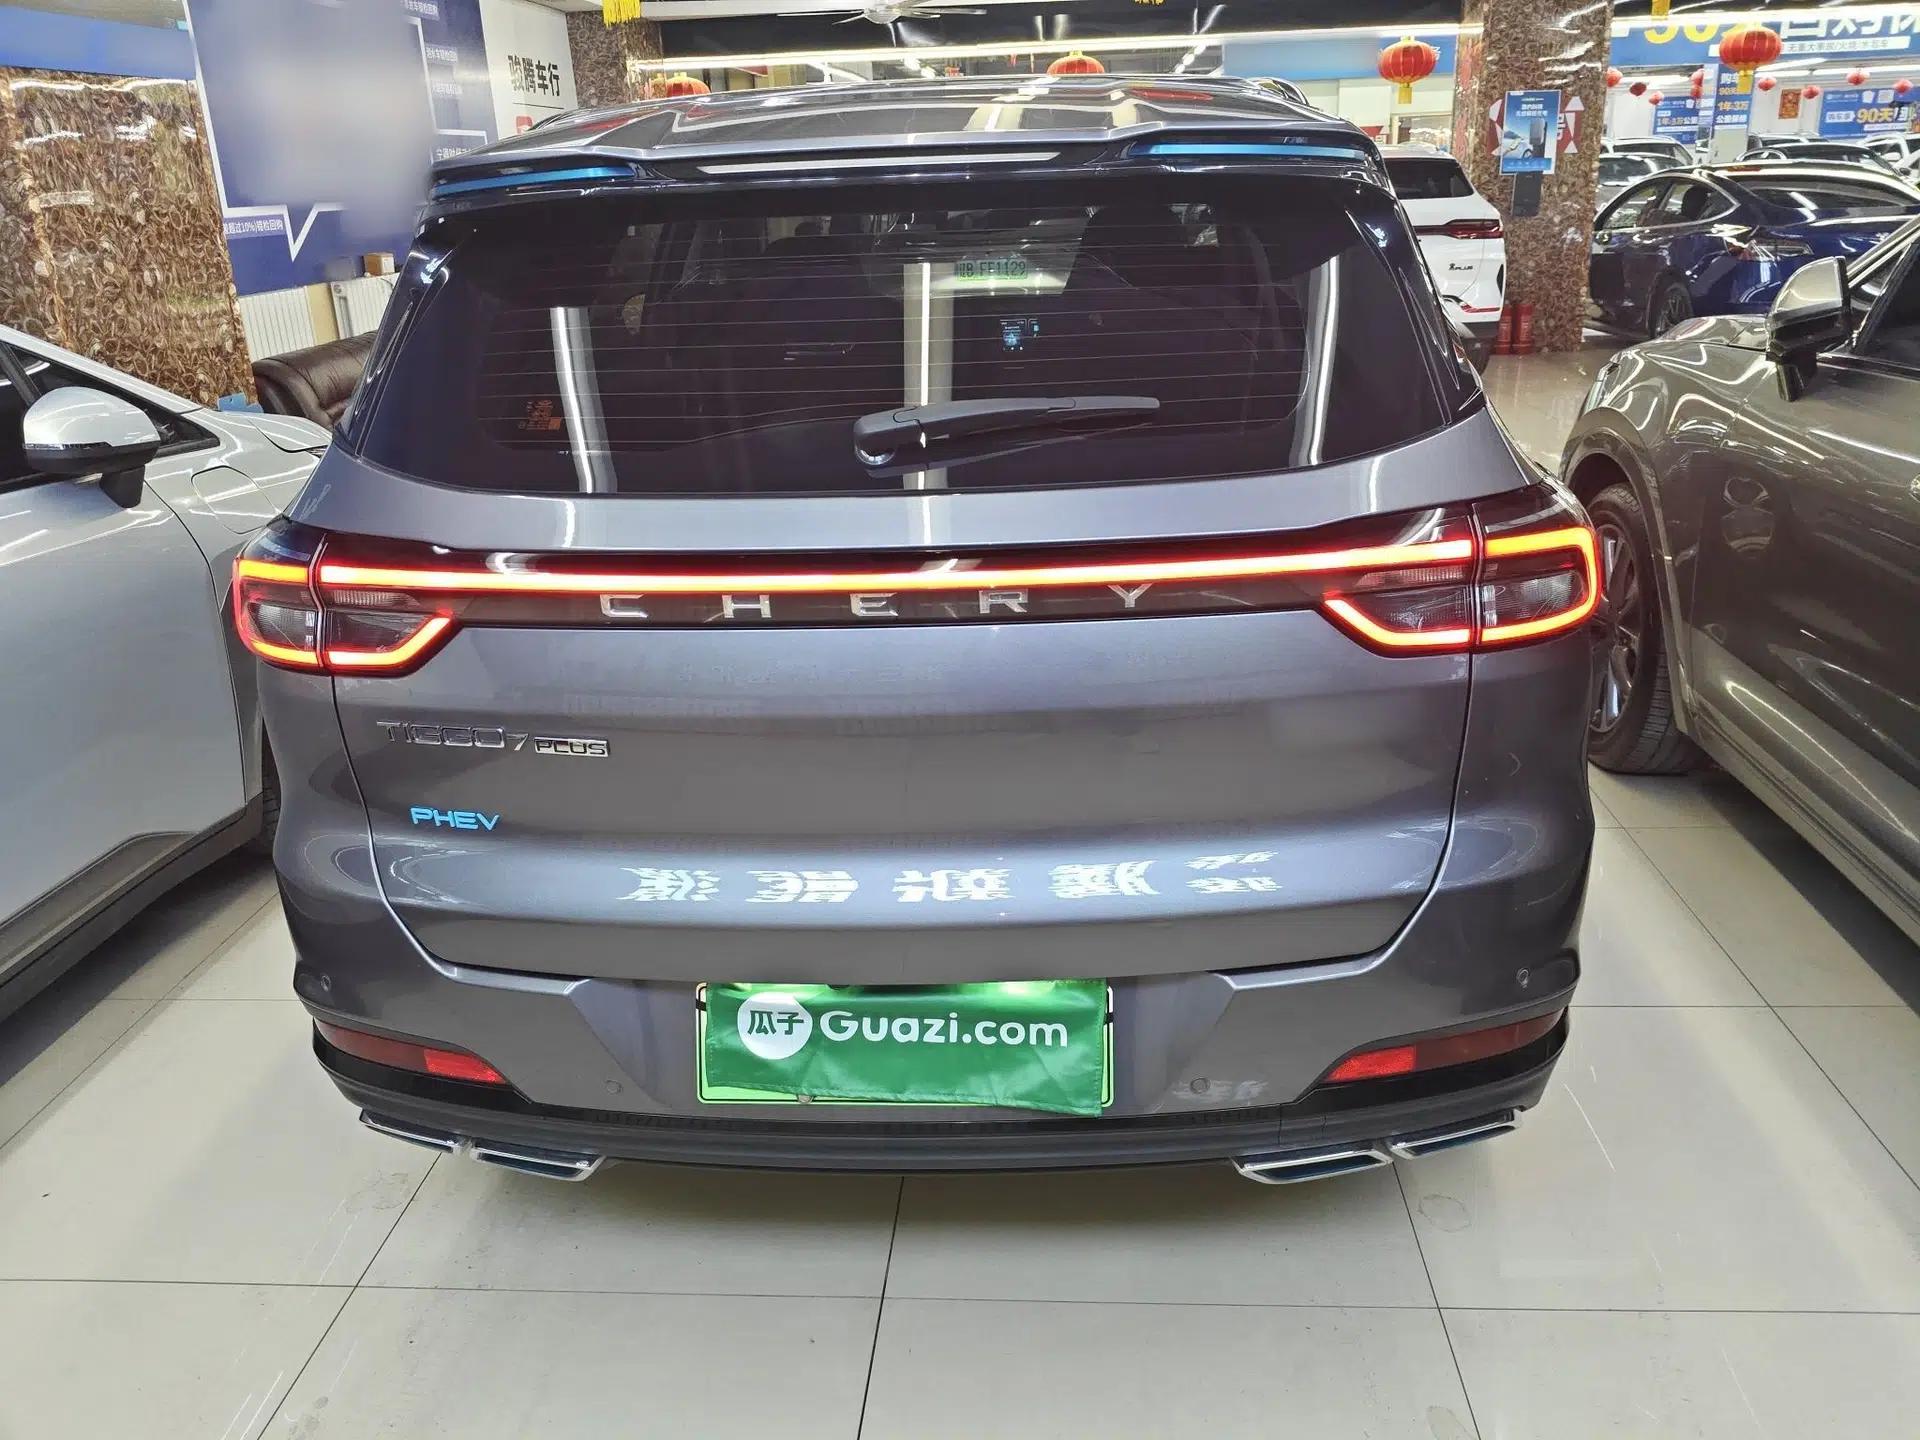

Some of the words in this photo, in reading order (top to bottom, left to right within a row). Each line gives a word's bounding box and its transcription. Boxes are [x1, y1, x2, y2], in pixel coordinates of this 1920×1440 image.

[508, 55, 560, 96] 骏腾车行
[600, 583, 1153, 619] CHERY
[534, 737, 609, 757] PLUS
[410, 807, 500, 831] PHEV
[747, 1009, 805, 1036] 瓜子
[819, 1010, 1069, 1048] Guazi.com
